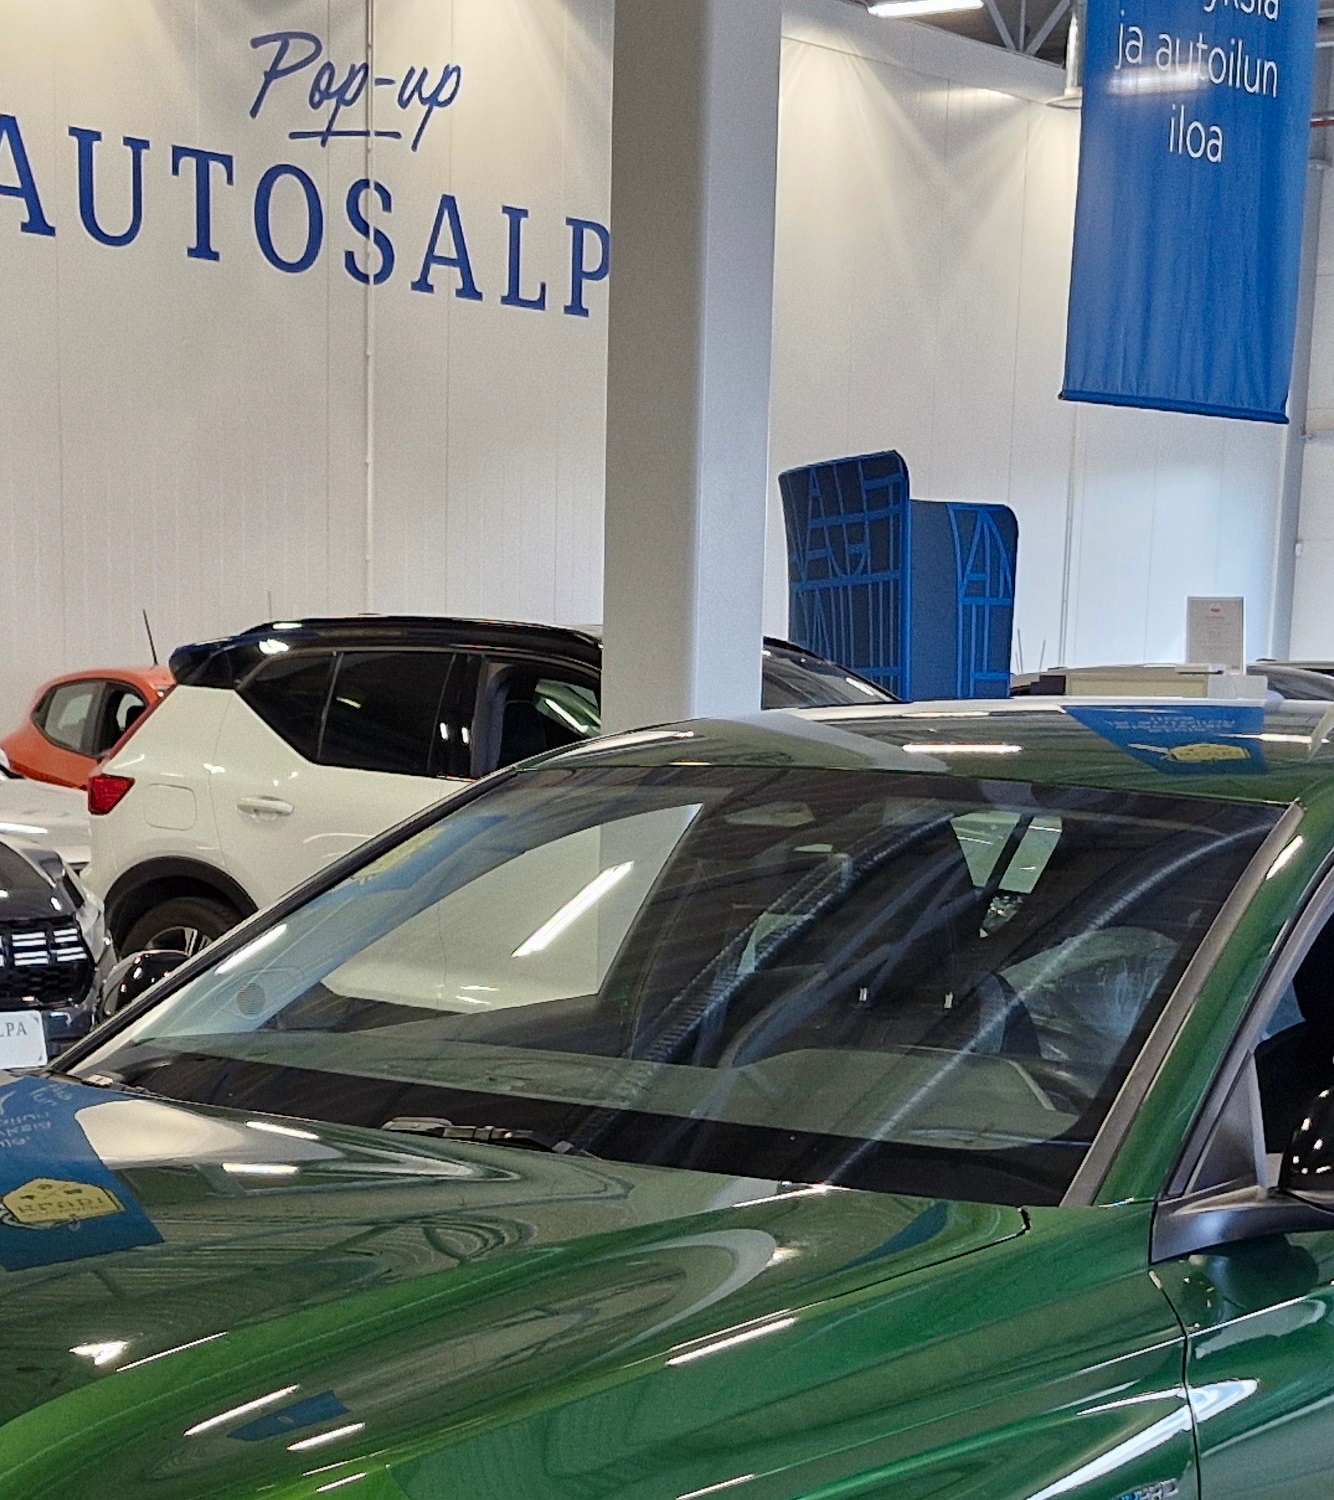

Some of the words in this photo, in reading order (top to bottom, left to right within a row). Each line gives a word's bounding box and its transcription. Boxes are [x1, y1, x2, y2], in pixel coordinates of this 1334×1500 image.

[250, 31, 462, 151] Pop-up
[1114, 9, 1143, 70] ja
[1156, 32, 1279, 98] autoilun
[1169, 104, 1224, 163] iloa
